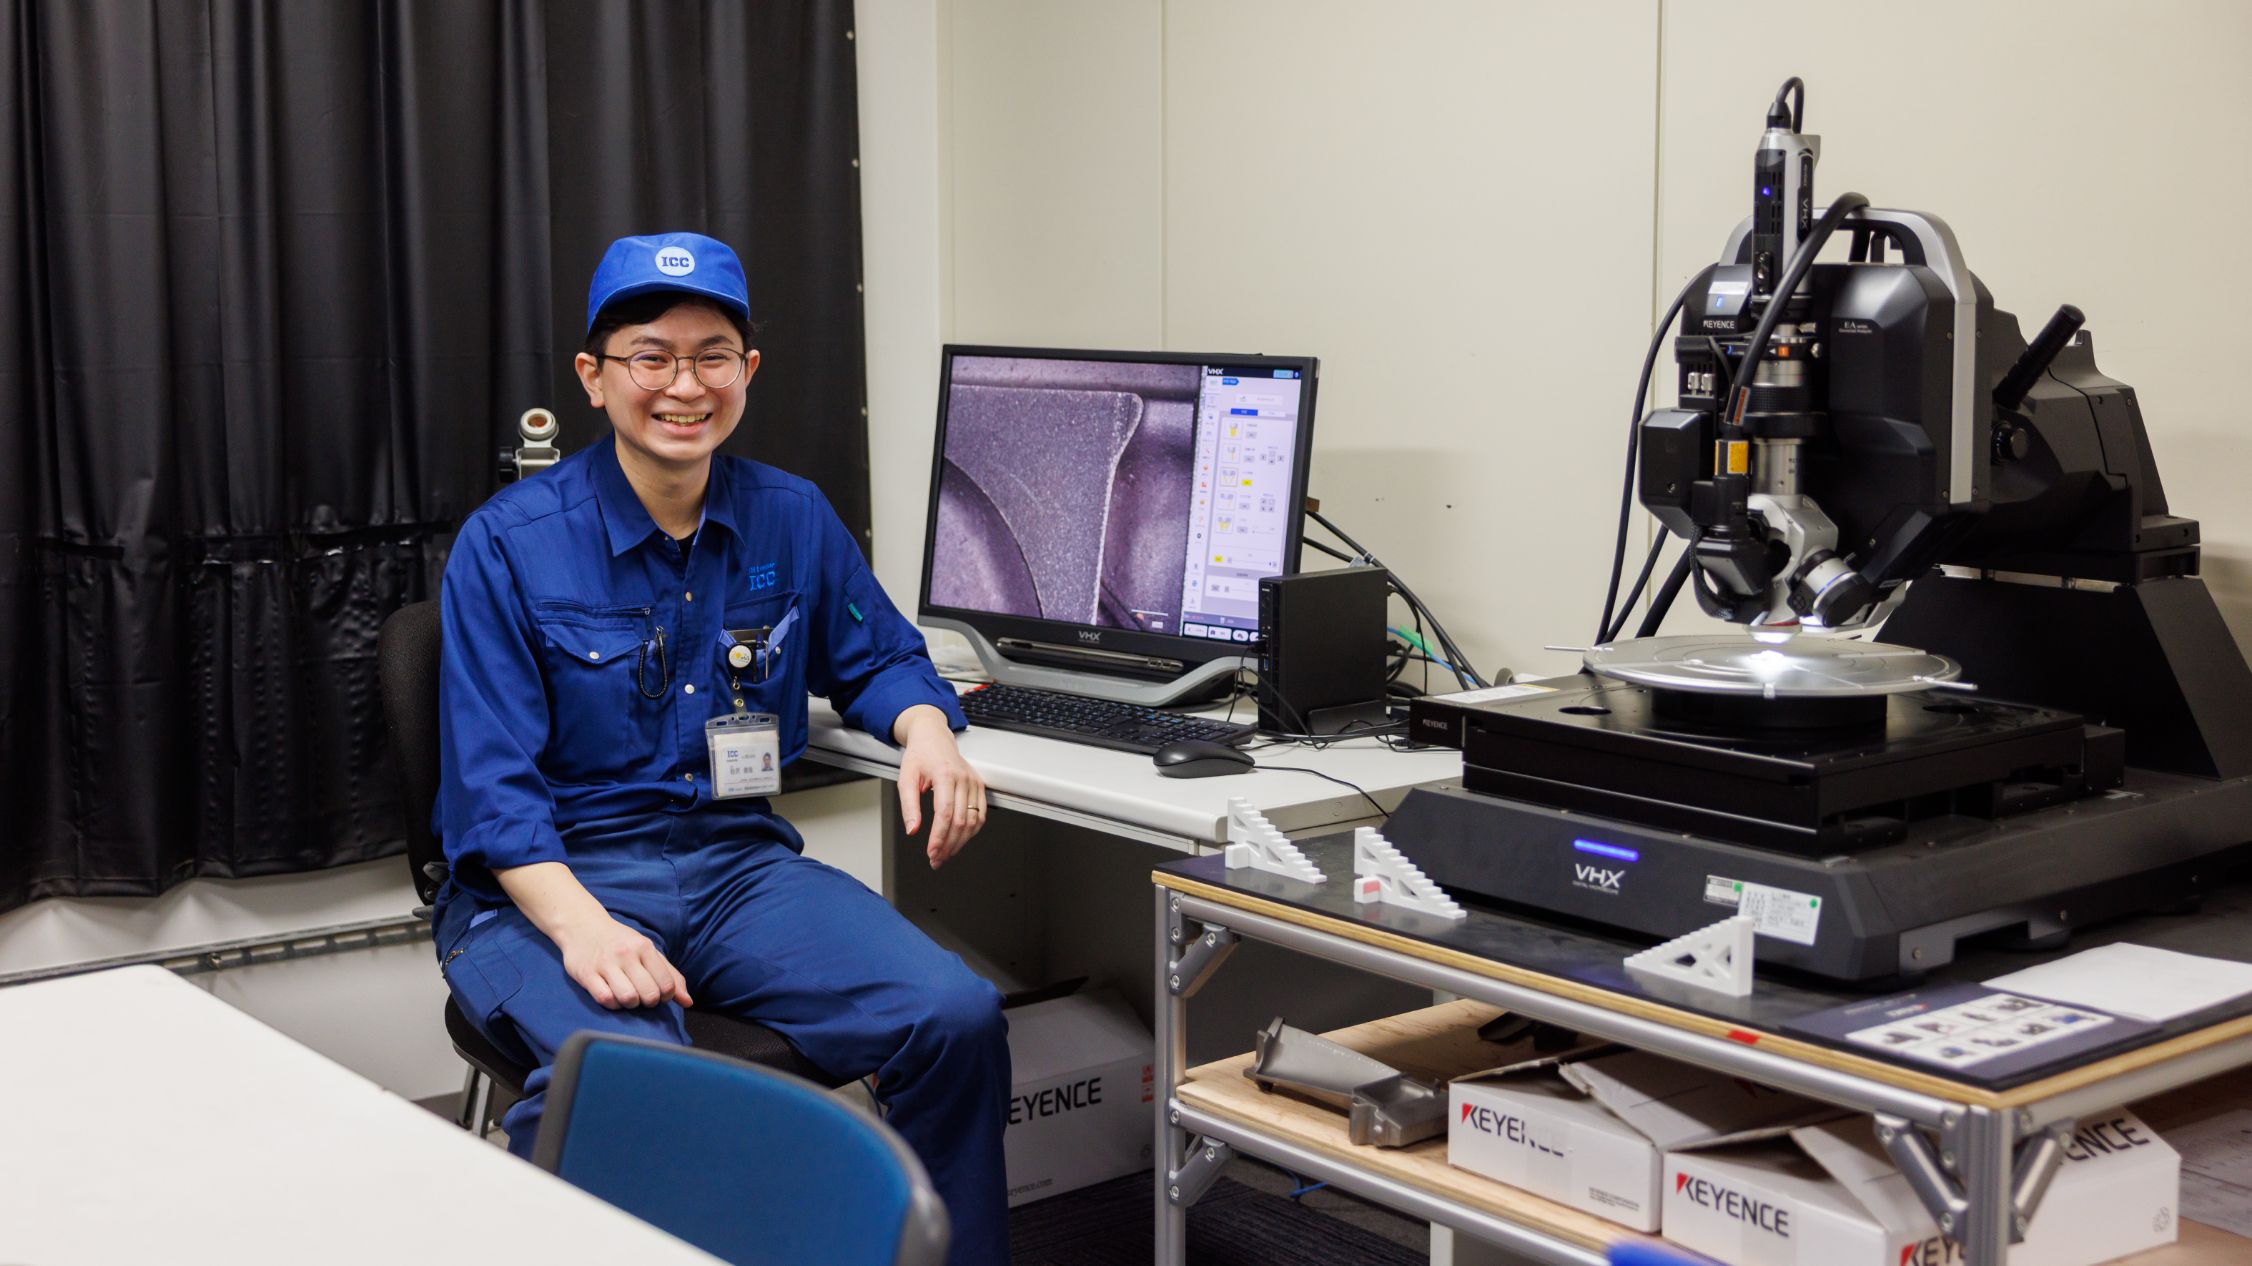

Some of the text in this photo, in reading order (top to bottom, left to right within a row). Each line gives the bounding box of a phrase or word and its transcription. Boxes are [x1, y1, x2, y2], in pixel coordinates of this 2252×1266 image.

[661, 256, 690, 268] ICC
[1703, 320, 1735, 329] KEYENCE
[749, 571, 775, 591] ICC
[1078, 630, 1101, 641] VHX
[1422, 718, 1448, 730] KEYENCE
[1575, 863, 1626, 888] VHX
[1008, 1077, 1102, 1125] EYENCE
[1676, 1172, 1790, 1238] KEYENCE
[1901, 1235, 1967, 1266] KEY
